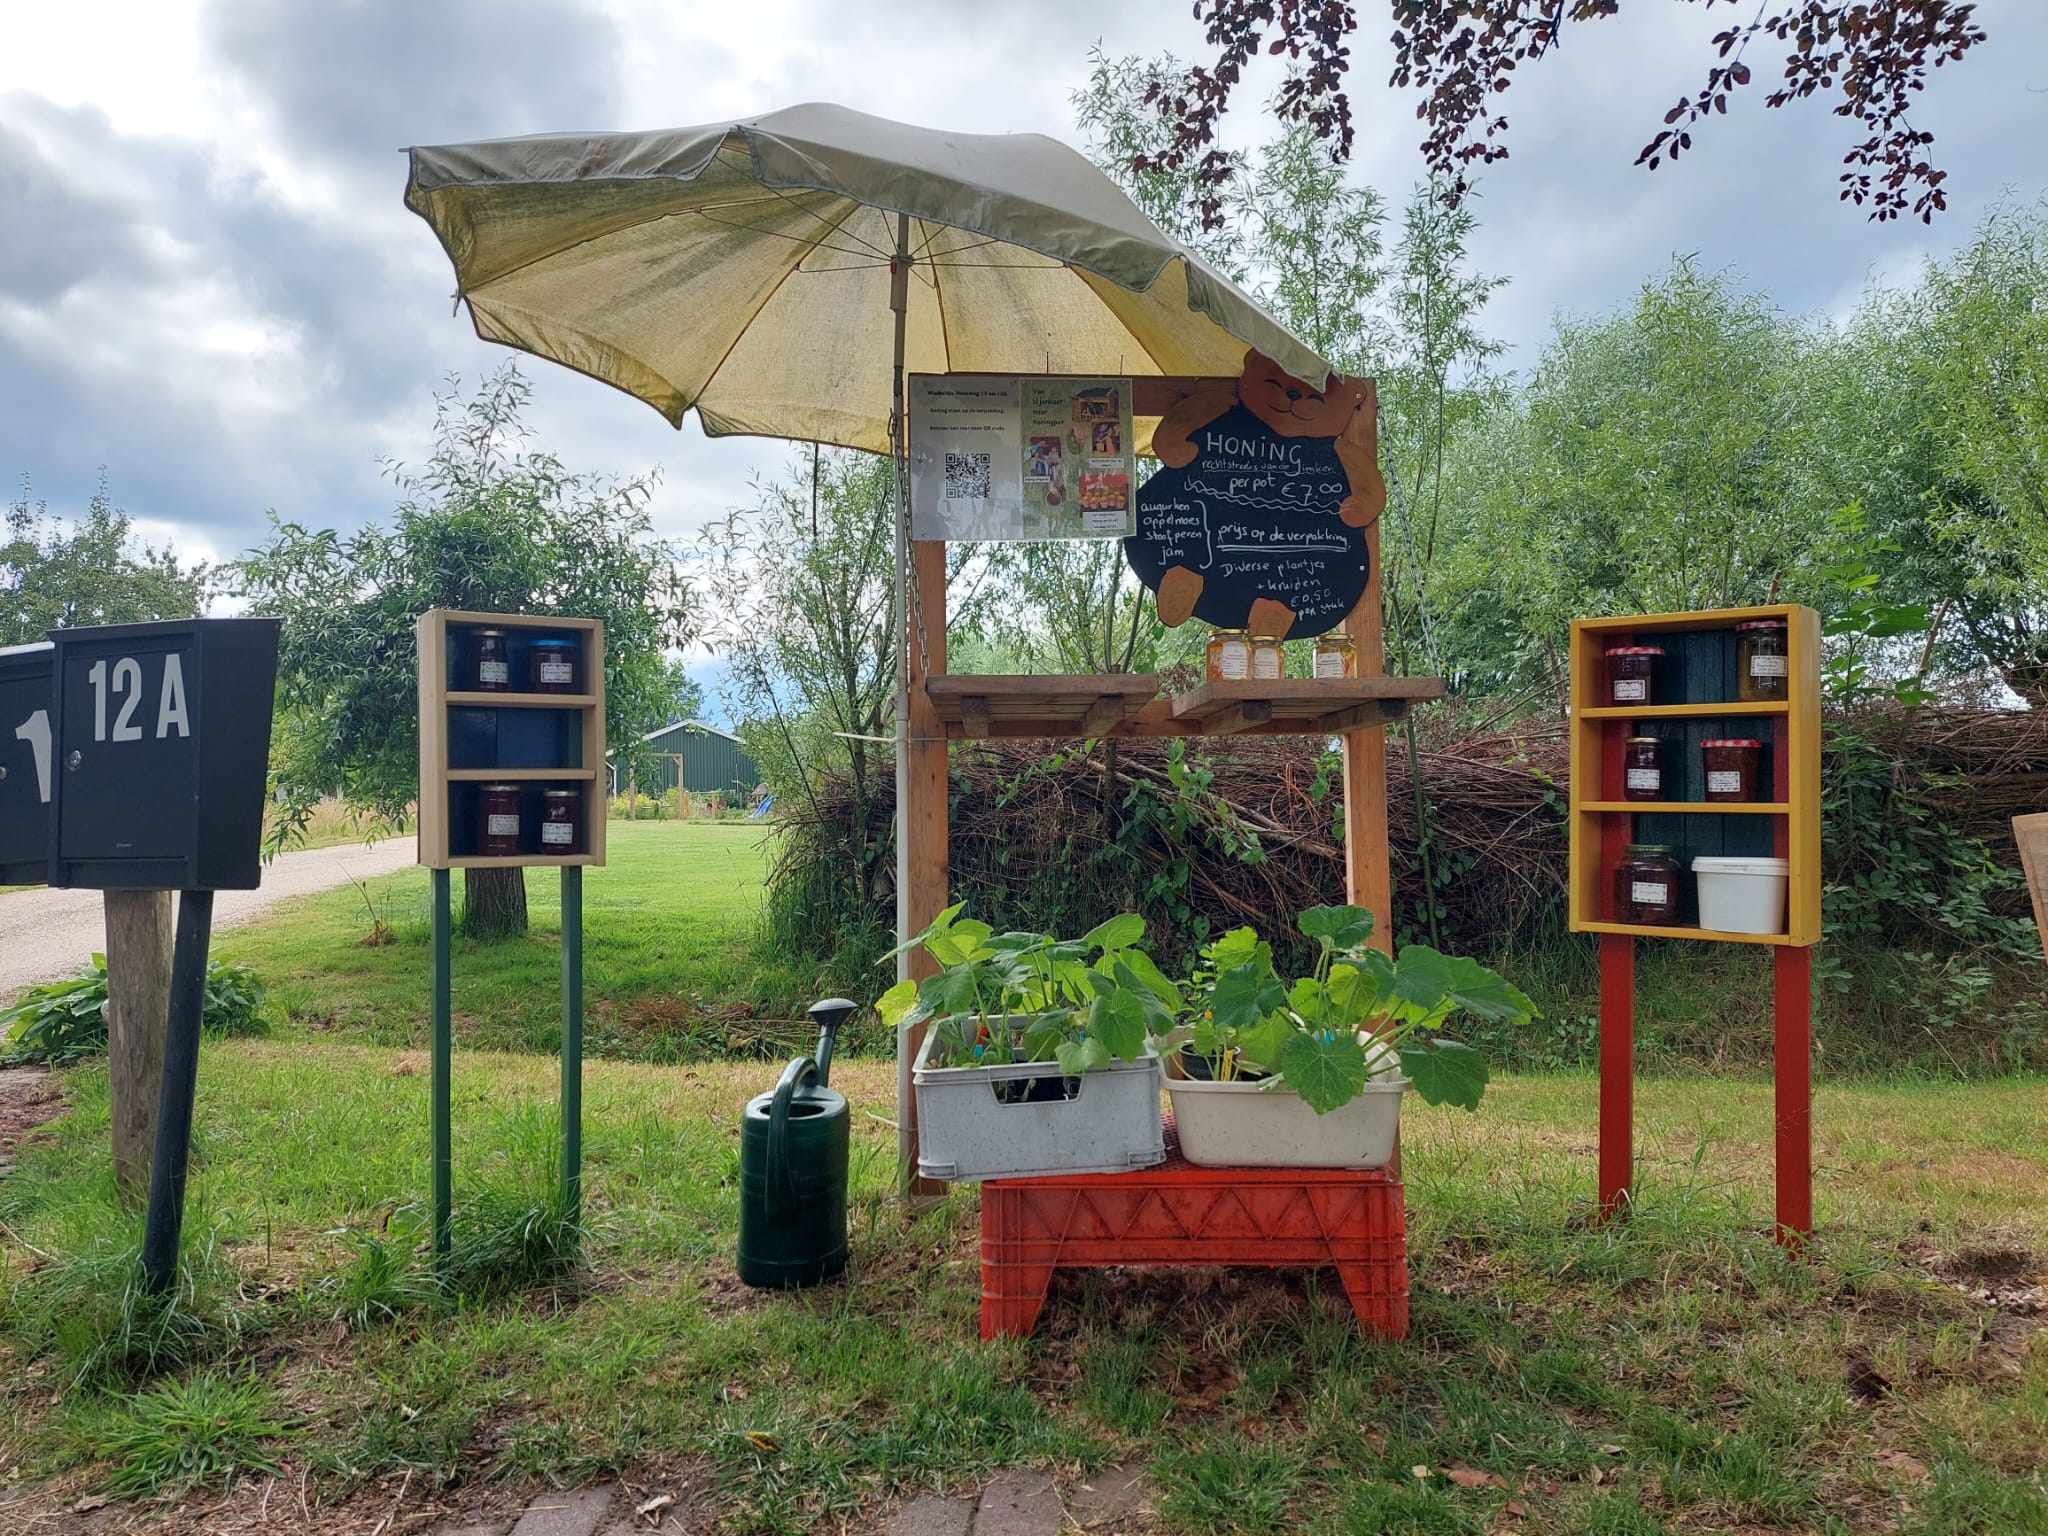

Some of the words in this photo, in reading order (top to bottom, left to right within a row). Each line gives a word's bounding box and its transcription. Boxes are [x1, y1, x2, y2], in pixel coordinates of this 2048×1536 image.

[1229, 477, 1249, 495] per
[1252, 471, 1277, 491] pot
[1140, 496, 1190, 517] augurken
[1217, 521, 1248, 544] prijs
[1250, 529, 1265, 542] op
[1269, 525, 1285, 541] de
[1158, 545, 1184, 566] jam
[1220, 561, 1270, 577] Diverse
[1277, 559, 1325, 577] plantjes
[1267, 577, 1321, 591] kruiden
[1298, 607, 1317, 622] per
[89, 657, 142, 742] 12
[156, 653, 190, 738] A
